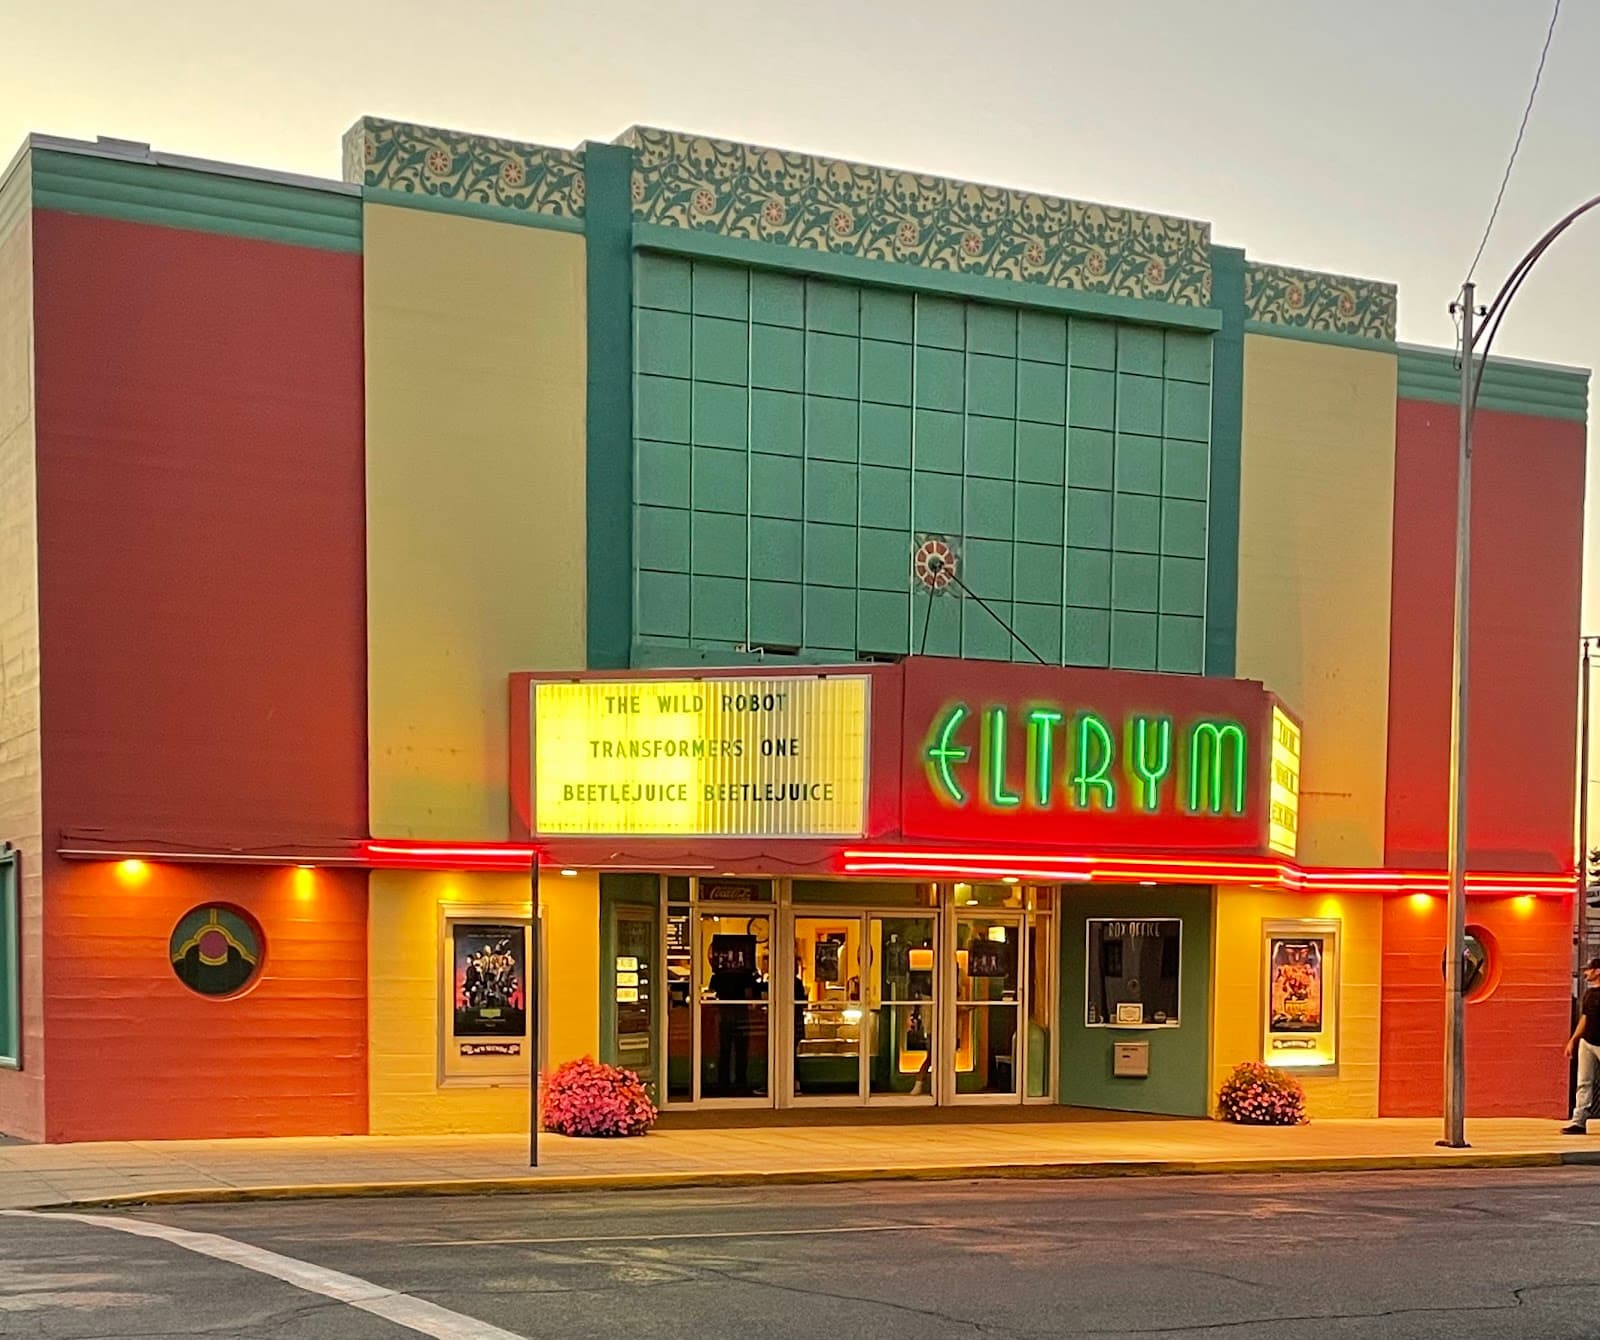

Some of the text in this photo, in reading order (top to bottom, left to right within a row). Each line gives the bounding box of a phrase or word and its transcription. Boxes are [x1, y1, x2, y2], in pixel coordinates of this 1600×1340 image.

[605, 693, 787, 713] THE WILD ROBOT
[590, 738, 800, 758] TRANSFORMERS ONE
[925, 702, 1247, 815] ELTRYM
[563, 783, 834, 802] BEETLEJUICE BEETLEJUICE
[1108, 922, 1160, 937] BOX OFFICE
